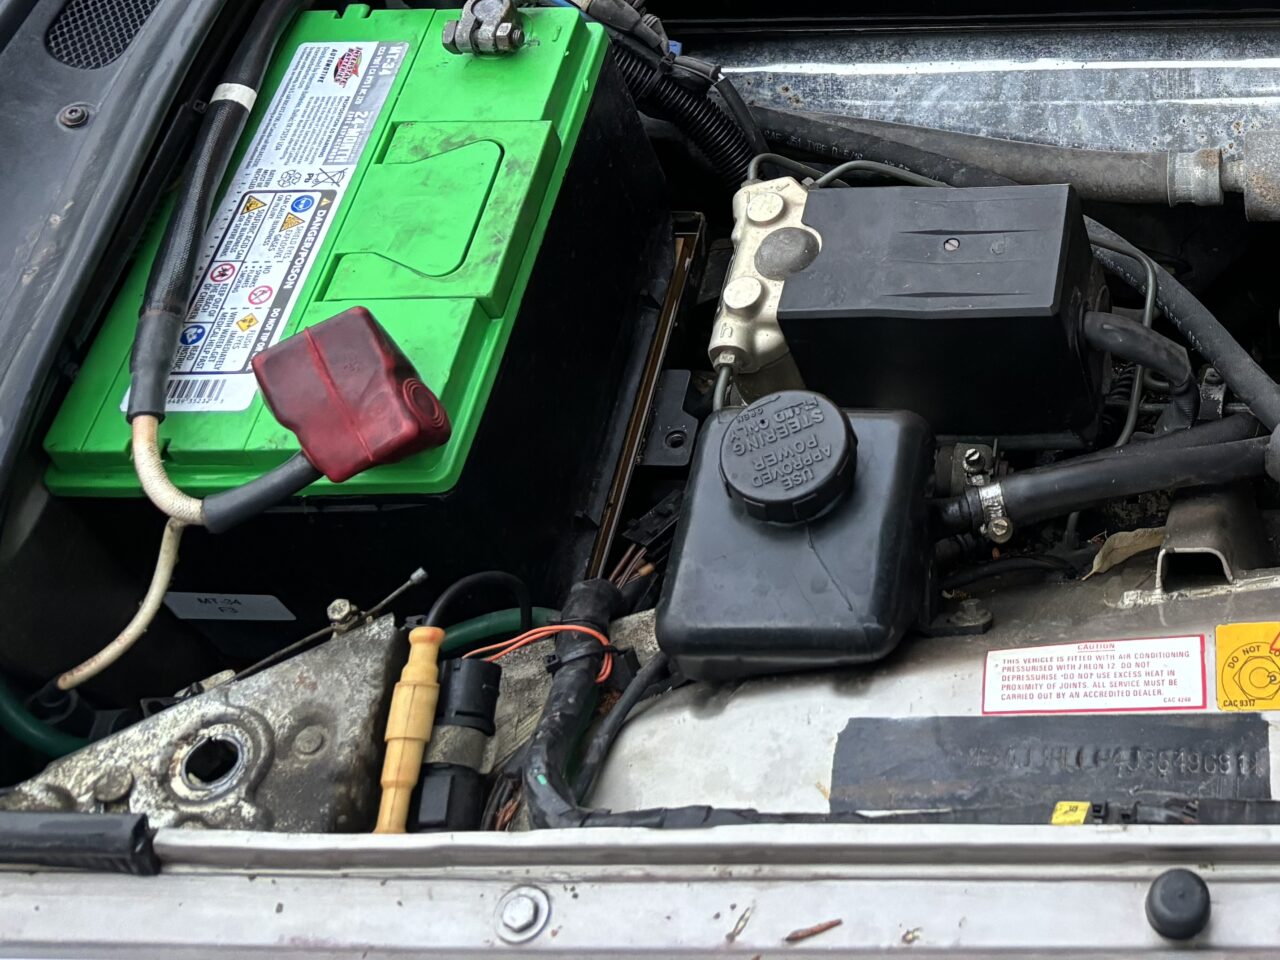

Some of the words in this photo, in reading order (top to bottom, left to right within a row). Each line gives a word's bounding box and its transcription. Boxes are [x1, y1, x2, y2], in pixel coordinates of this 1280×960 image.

[316, 48, 338, 83] AUTOMOTIVE
[377, 46, 402, 75] MT-34
[332, 111, 369, 162] 24-MONTH
[317, 134, 333, 157] WARNING
[303, 172, 313, 183] Pb
[281, 194, 292, 203] CAN
[242, 211, 255, 226] CAUSE
[274, 204, 287, 218] CAUSE
[245, 209, 265, 234] SULFURIC
[227, 223, 242, 239] SEVERE
[261, 218, 280, 246] BLINDNESS
[288, 225, 304, 244] SHIELD
[229, 227, 248, 252] BLINDNESS
[239, 235, 252, 248] ACID
[266, 234, 281, 251] GASES
[272, 229, 293, 258] EXPLOSIVE
[233, 249, 245, 259] CAN
[281, 209, 328, 288] DANGER/POISON
[261, 265, 272, 274] NO
[231, 269, 248, 293] SMOKING
[240, 269, 255, 288] FLAMES
[247, 269, 262, 288] SPARKS
[202, 283, 212, 291] OF
[209, 283, 220, 293] THE
[216, 283, 229, 297] KEEP
[200, 293, 216, 312] REACH
[210, 298, 222, 309] OUT
[224, 311, 238, 327] WITH
[269, 308, 281, 317] DO
[209, 312, 229, 339] MEDICAL
[263, 318, 276, 330] NOT
[231, 335, 244, 349] EYES
[240, 329, 256, 349] FLUSH
[258, 331, 270, 341] TIP
[185, 345, 199, 360] READ
[202, 339, 215, 354] HELP
[212, 330, 237, 370] IMMEDIATELY
[733, 410, 824, 456] STEERING
[752, 434, 818, 471] POWER
[752, 445, 831, 487] APPROVED
[782, 468, 814, 491] USE
[197, 598, 242, 606] MT-34
[1134, 651, 1190, 659] CONDITIONING
[1227, 654, 1240, 670] DO
[1242, 645, 1261, 656] NOT
[1002, 664, 1053, 672] PRESSURISED
[1056, 663, 1076, 671] WITH
[1001, 673, 1057, 681] DEPRESSURISE
[1001, 682, 1043, 691] PROXIMITY
[1059, 681, 1089, 689] JOINTS.
[1109, 680, 1140, 688] SERVICE
[1143, 679, 1166, 687] MUST
[1001, 693, 1034, 701] CARRIED
[1083, 690, 1130, 698] ACCREDITED
